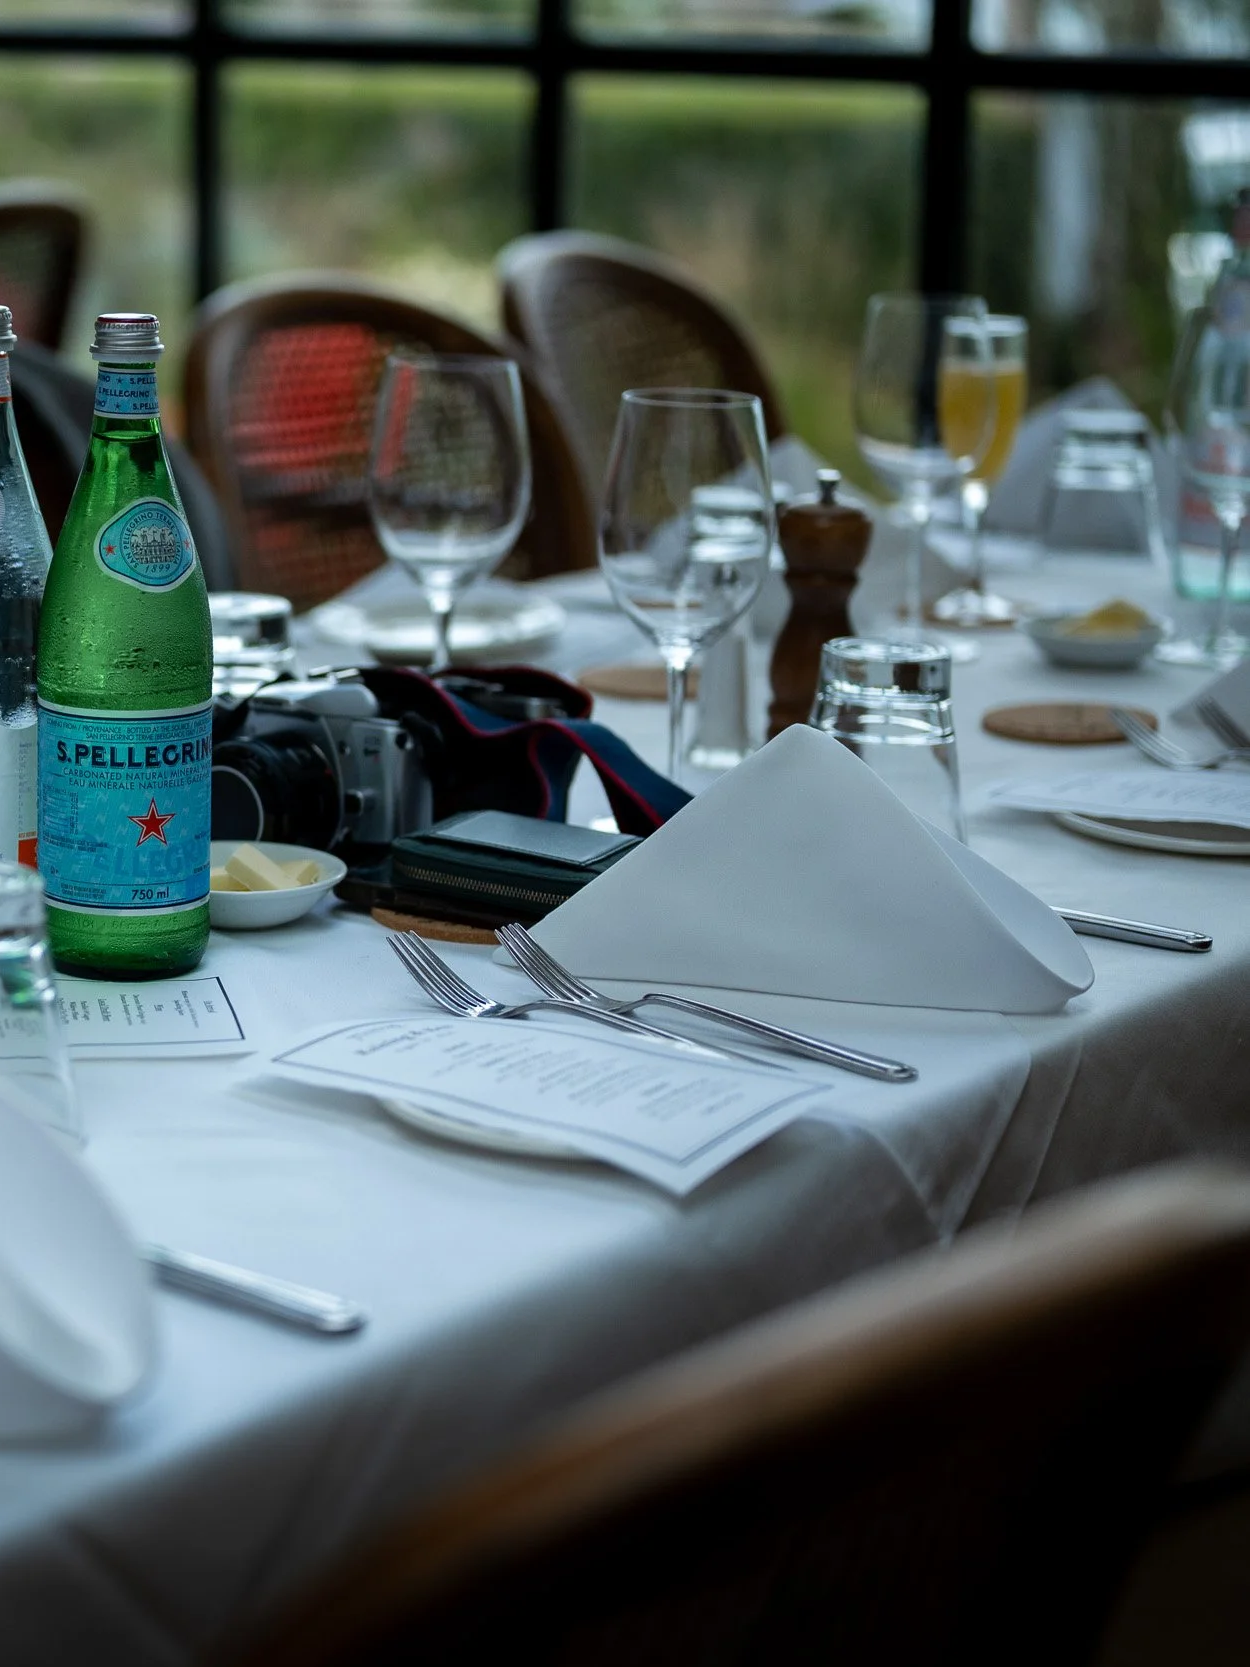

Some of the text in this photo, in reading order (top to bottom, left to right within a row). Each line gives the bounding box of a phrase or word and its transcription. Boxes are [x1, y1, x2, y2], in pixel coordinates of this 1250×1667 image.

[122, 511, 154, 550] PELLEGRINO
[125, 551, 140, 569] SAN
[82, 725, 121, 734] PROVENANCE
[127, 726, 152, 734] BOTTLED
[86, 732, 99, 740] SAN
[57, 735, 211, 769] S.PELLEGRIN
[63, 767, 122, 781] CARBONATED
[126, 771, 167, 781] NATURAL
[171, 766, 200, 778] MINERAL
[69, 777, 85, 787] EAU
[139, 778, 185, 790] NATURELLE
[131, 886, 170, 900] 750 ml
